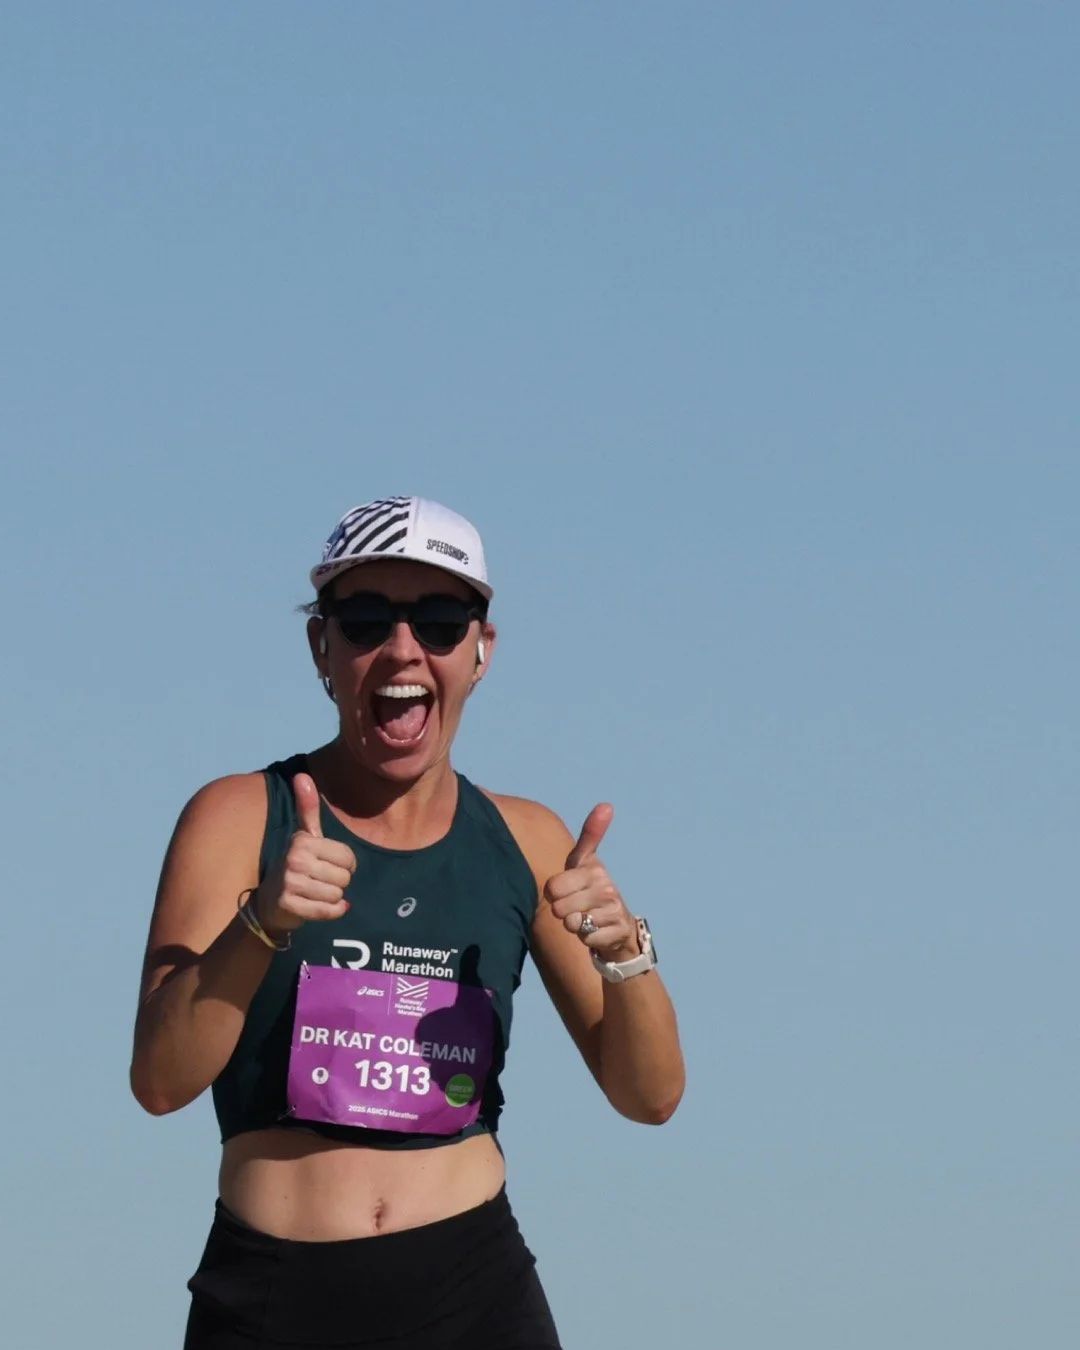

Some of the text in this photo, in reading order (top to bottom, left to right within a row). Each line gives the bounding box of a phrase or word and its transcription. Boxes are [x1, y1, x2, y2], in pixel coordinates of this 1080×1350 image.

[382, 958, 453, 978] Marathon
[300, 1026, 476, 1064] DR KAT COLEMAN
[355, 1059, 431, 1096] 1313
